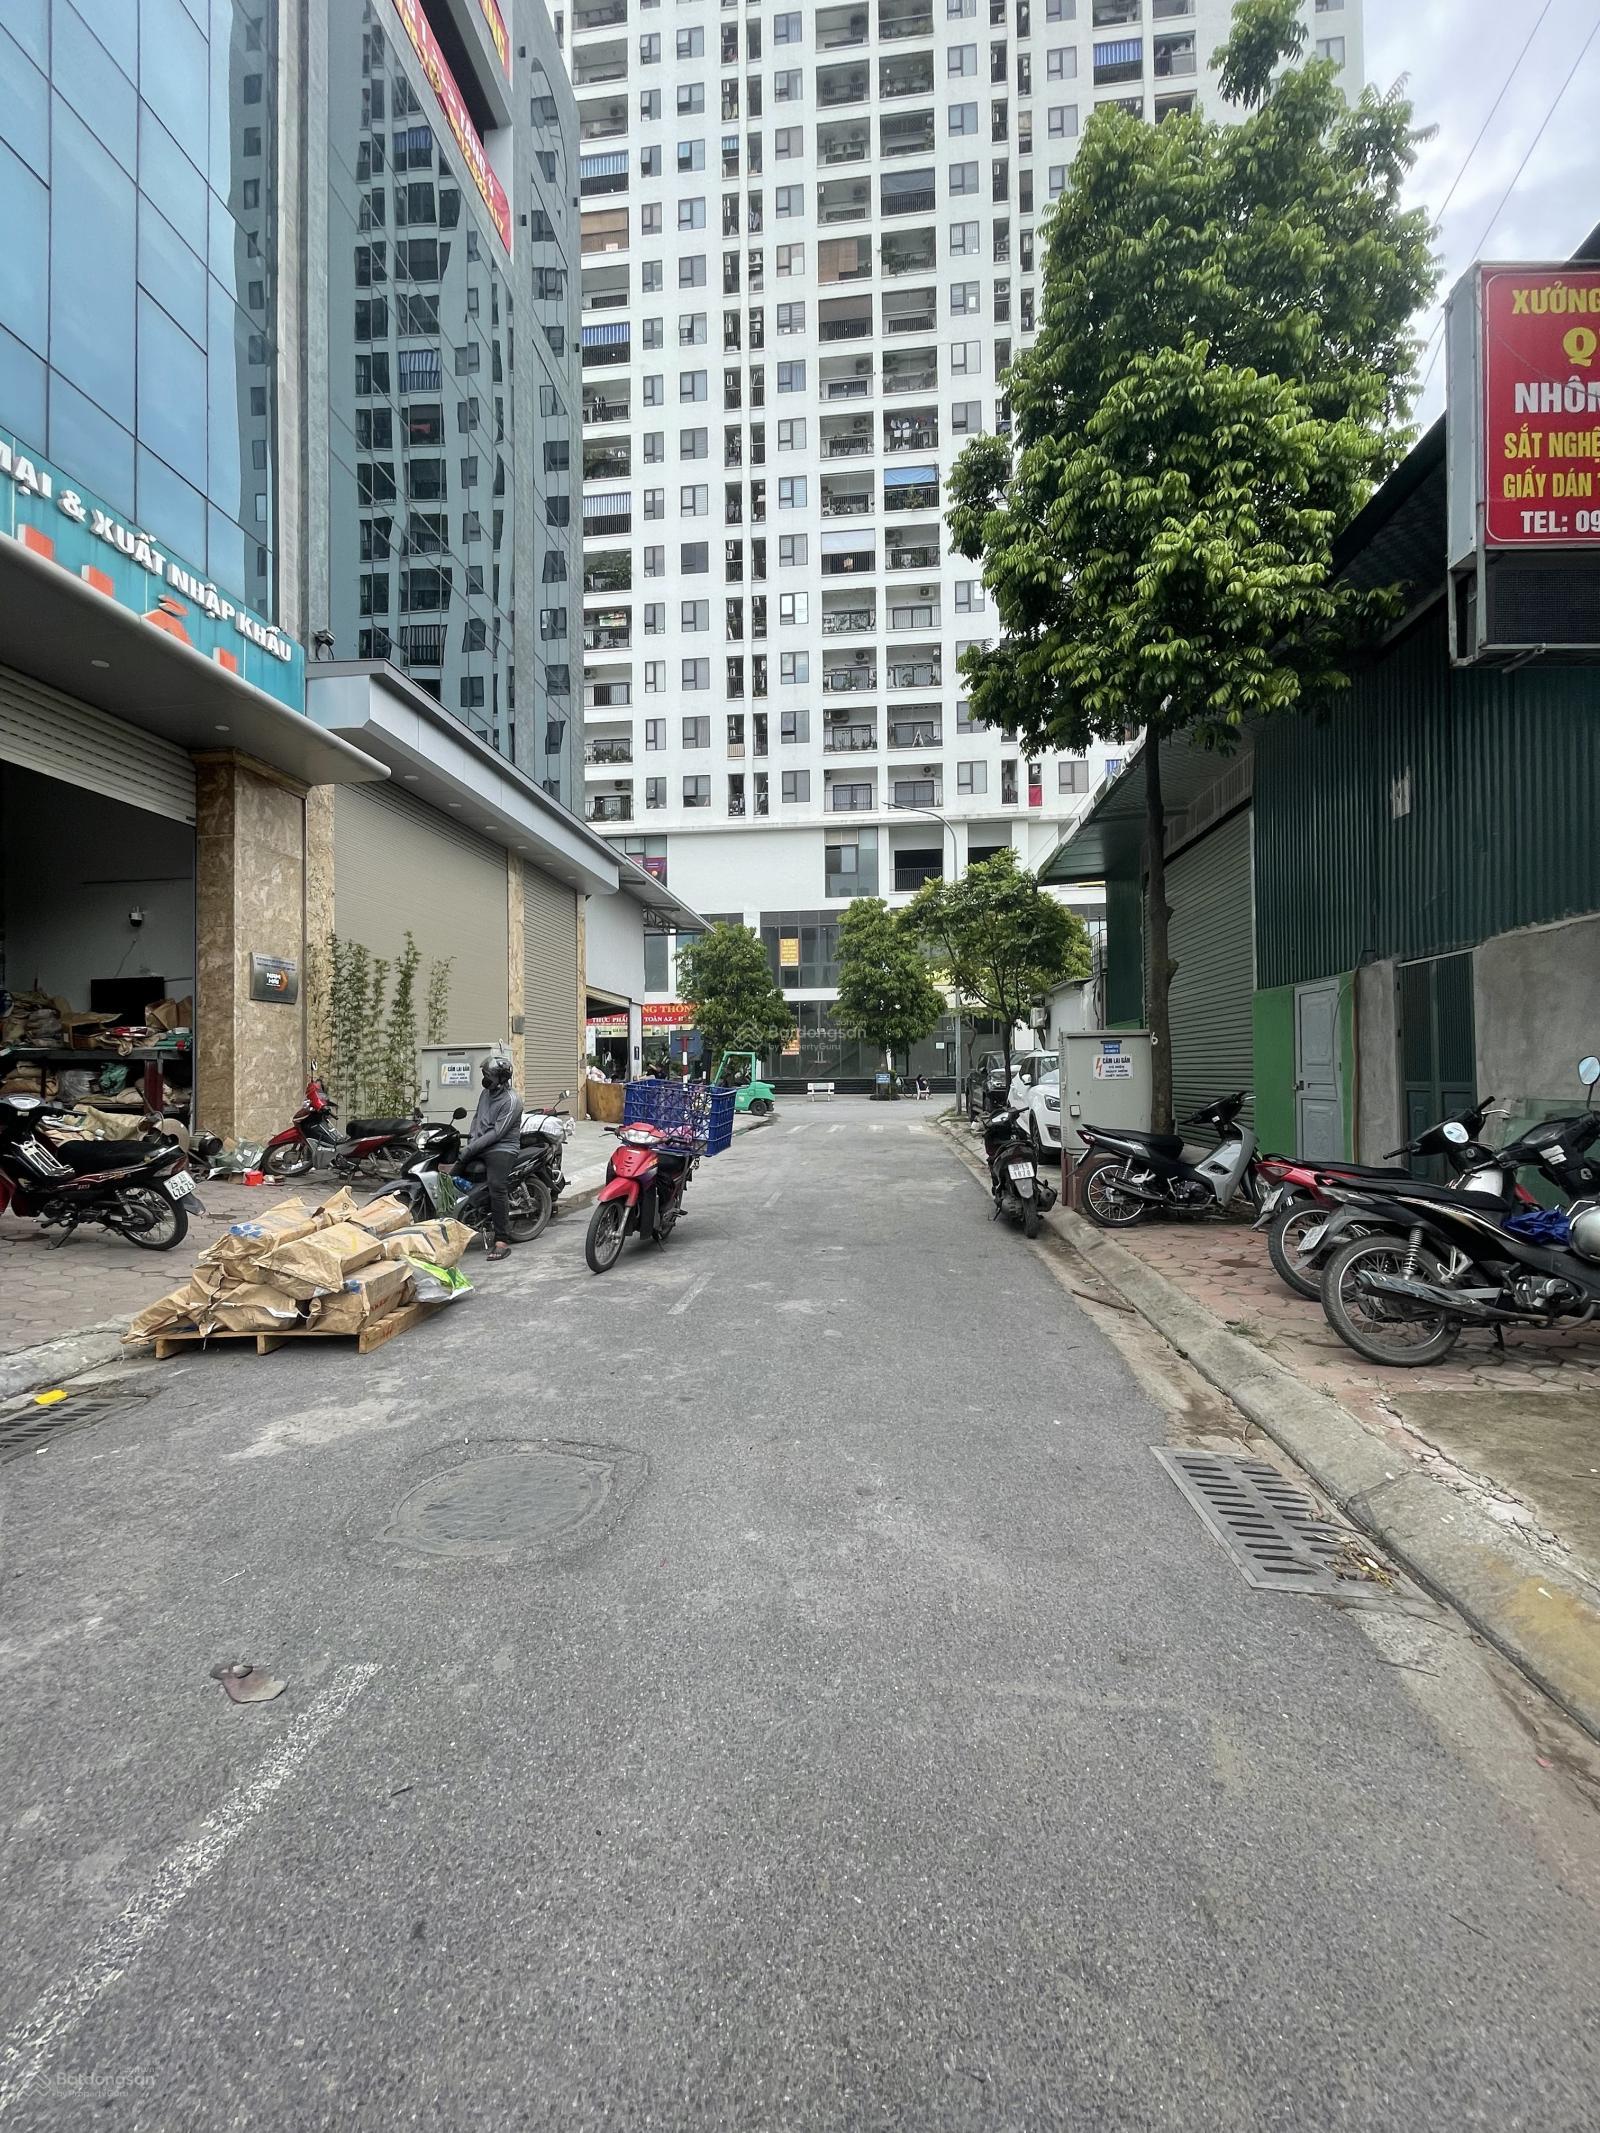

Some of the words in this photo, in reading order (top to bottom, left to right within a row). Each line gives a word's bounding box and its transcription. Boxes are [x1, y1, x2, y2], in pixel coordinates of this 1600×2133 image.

[1512, 280, 1600, 314] XƯỞNG
[1562, 327, 1600, 368] Q
[1504, 423, 1543, 459] SẮT
[1548, 426, 1600, 463] NGHỆ
[1503, 465, 1547, 499] GIẤY
[1552, 468, 1592, 498] DÁN
[1520, 510, 1568, 534] TEL:
[1575, 509, 1600, 533] 09
[58, 489, 86, 523] &
[90, 509, 167, 576] XUẤT
[167, 563, 236, 622] NHẬP
[235, 612, 292, 662] KHẨU
